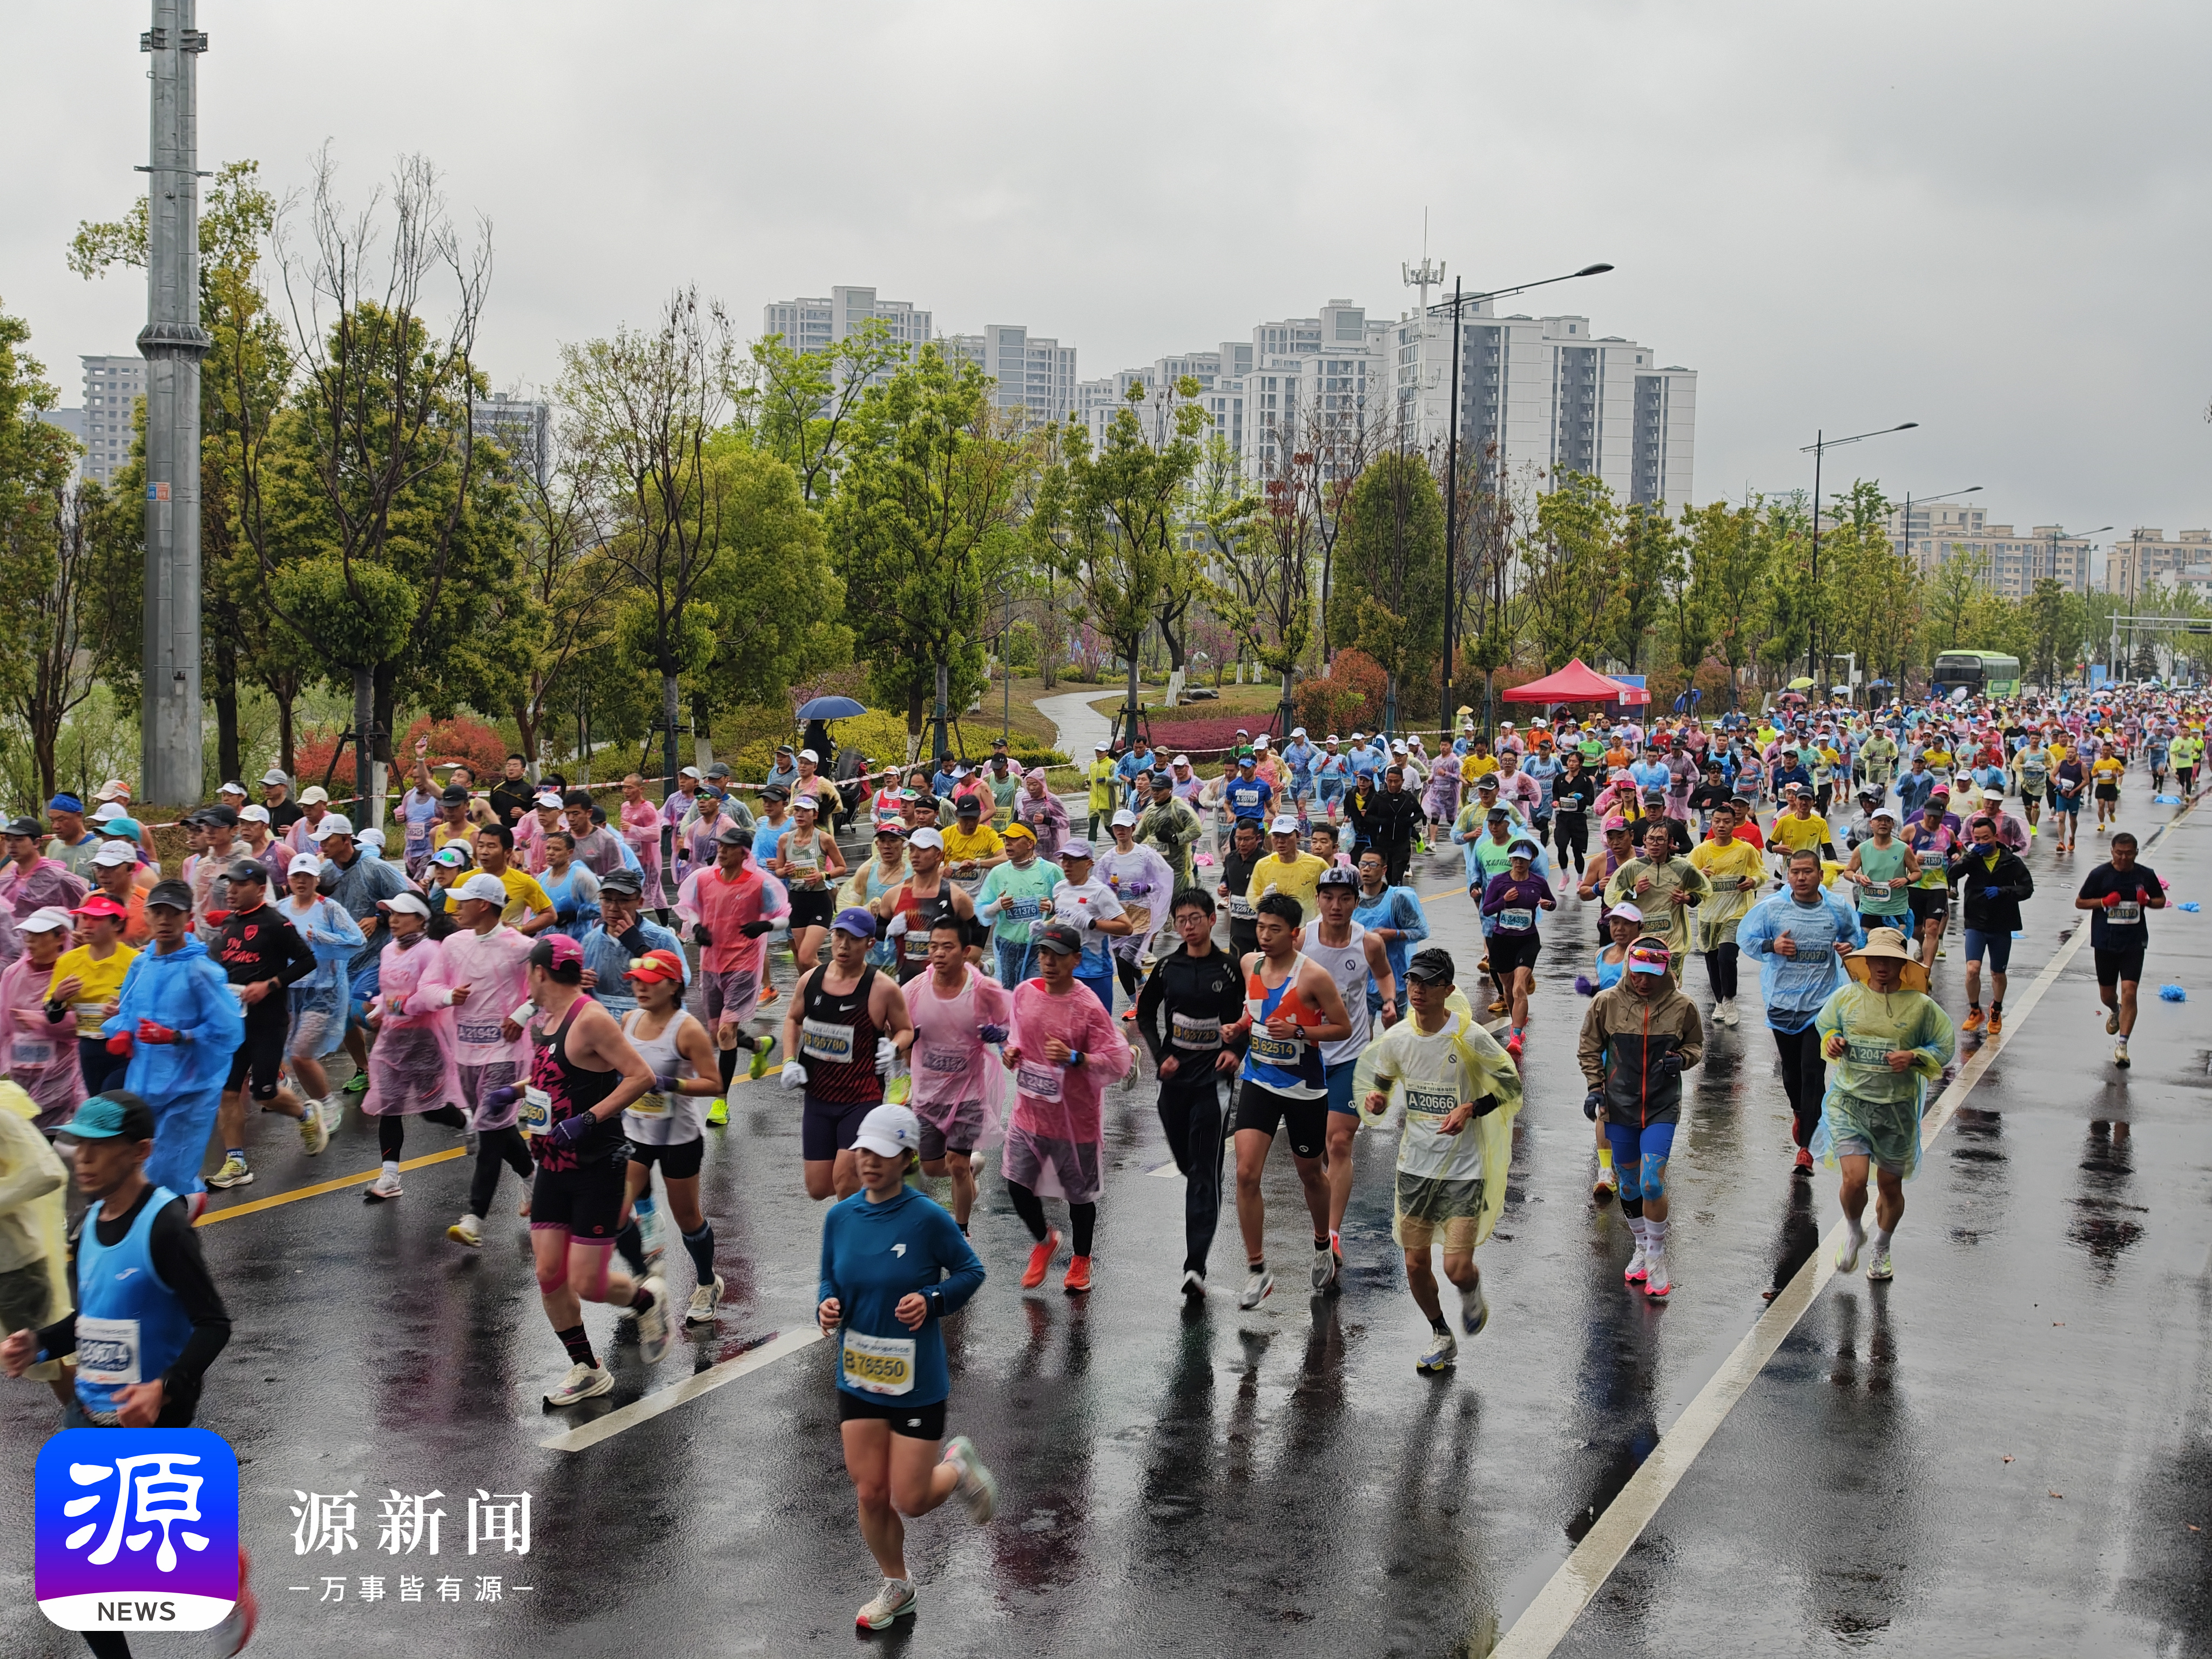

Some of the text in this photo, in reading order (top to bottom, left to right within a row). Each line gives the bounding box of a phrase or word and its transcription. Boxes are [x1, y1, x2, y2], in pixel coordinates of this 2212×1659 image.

[1260, 1040, 1293, 1055] 62514
[1860, 1048, 1891, 1061] 2047
[1408, 1093, 1454, 1109] A 20666
